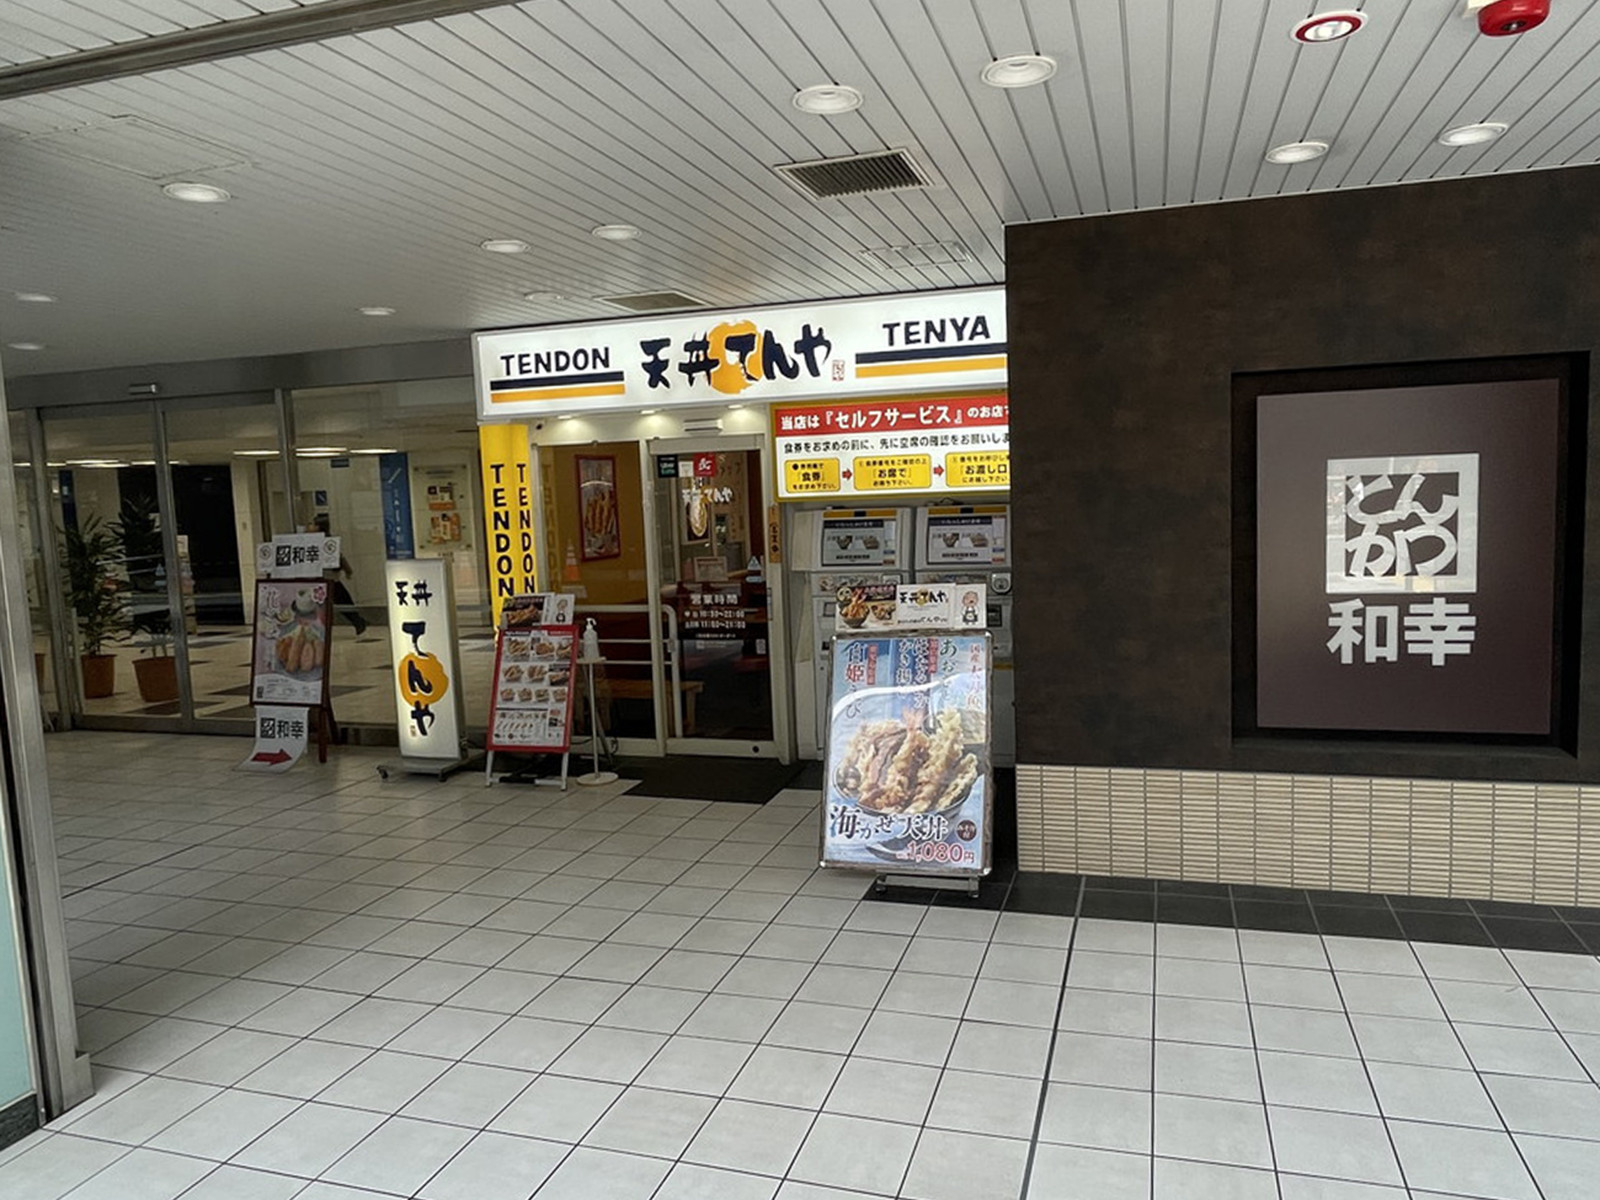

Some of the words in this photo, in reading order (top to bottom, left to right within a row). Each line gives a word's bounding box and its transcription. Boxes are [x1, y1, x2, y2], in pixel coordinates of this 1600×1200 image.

[882, 315, 991, 347] TENYA
[500, 347, 610, 376] TENDON
[640, 323, 833, 390] 天丼てんや
[490, 464, 514, 597] TENDON
[516, 464, 535, 594] TENDON
[292, 545, 320, 564] 和幸
[395, 579, 433, 606] 天丼
[1326, 597, 1477, 666] 和幸
[402, 621, 435, 736] てんや
[277, 719, 304, 739] 和幸
